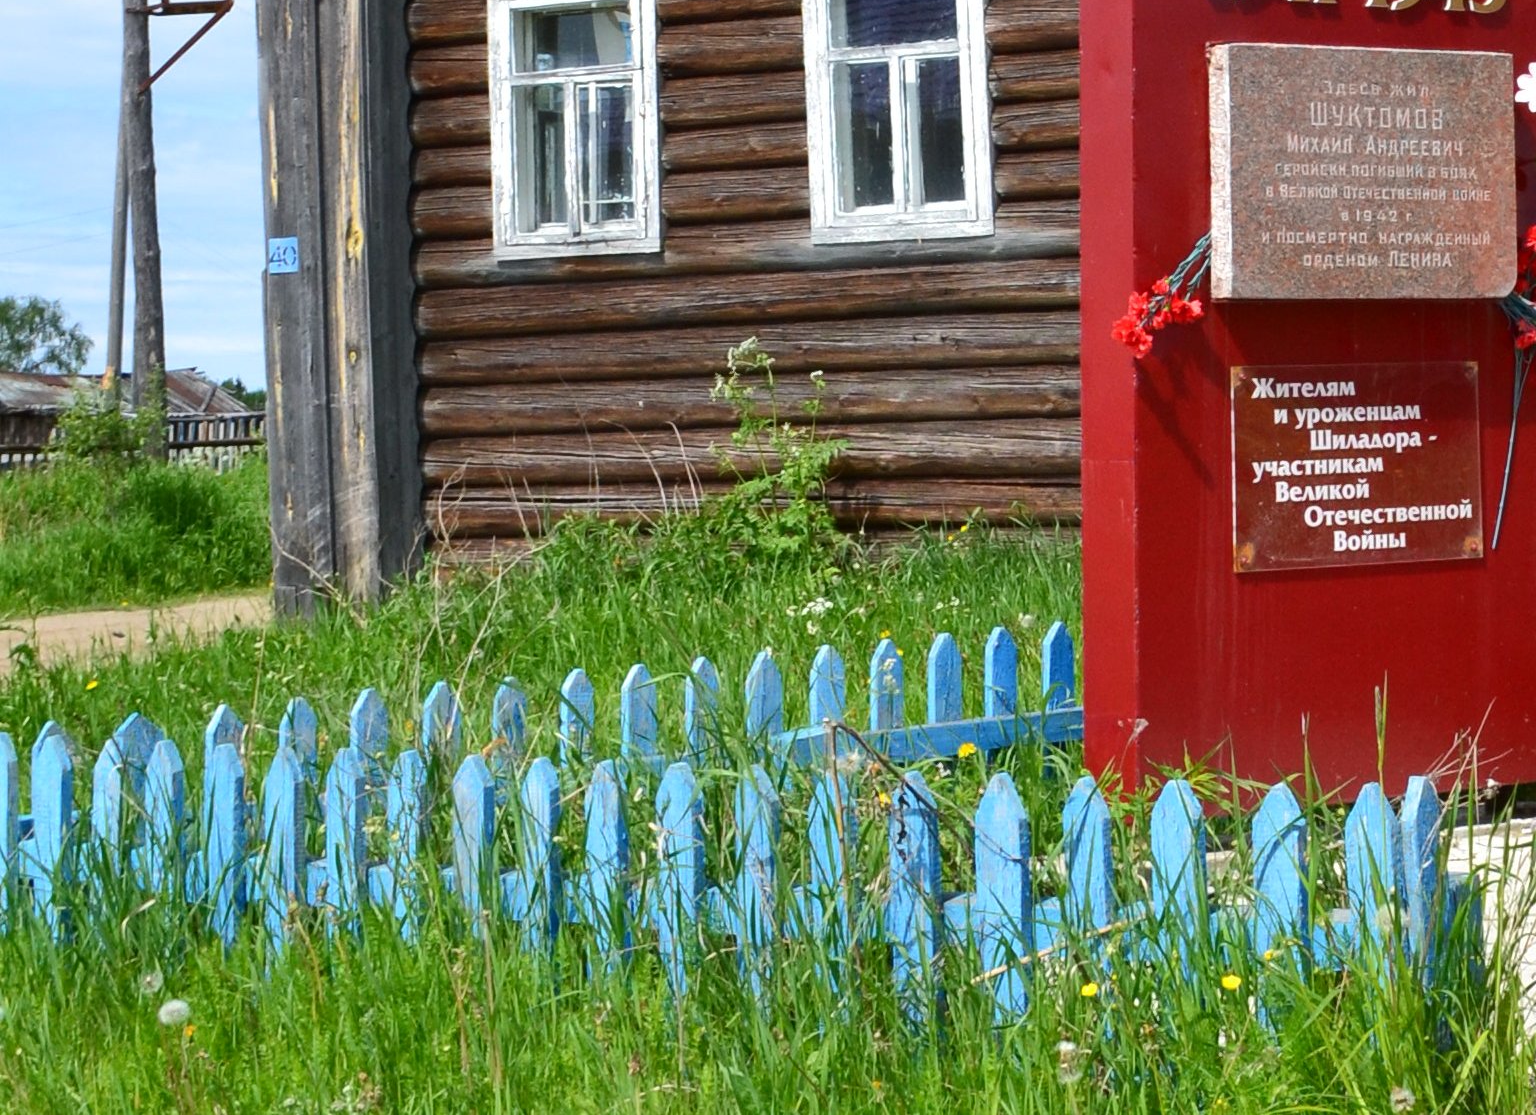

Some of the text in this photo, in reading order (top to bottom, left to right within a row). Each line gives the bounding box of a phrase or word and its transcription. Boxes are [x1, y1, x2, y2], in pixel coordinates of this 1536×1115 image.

[1309, 102, 1443, 130] ШУКТОМОВ
[1356, 209, 1398, 222] 1942
[1251, 377, 1356, 399] Жителям
[1274, 404, 1421, 429] и уроженцам
[1310, 429, 1422, 453] Шиладора
[1252, 457, 1384, 483] участникам
[1275, 479, 1370, 503] Великой
[1304, 499, 1473, 527] Отечественной
[1333, 530, 1406, 552] Войны
